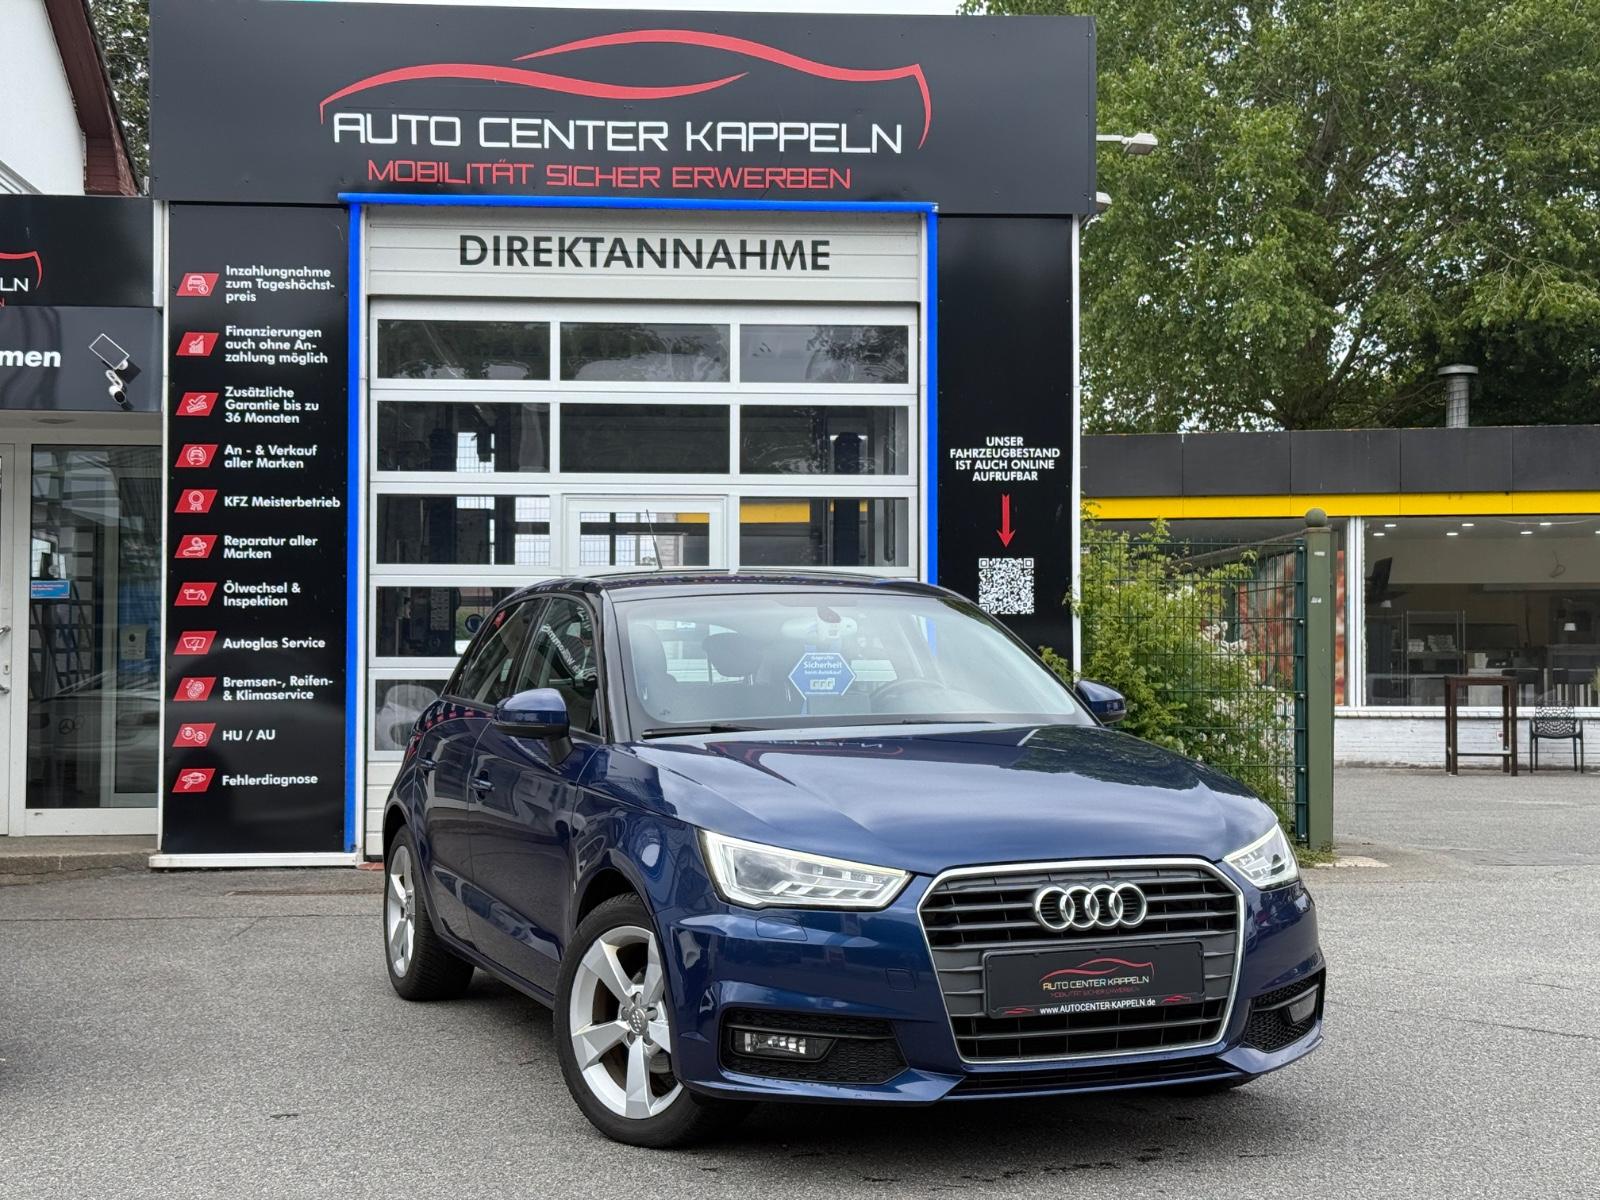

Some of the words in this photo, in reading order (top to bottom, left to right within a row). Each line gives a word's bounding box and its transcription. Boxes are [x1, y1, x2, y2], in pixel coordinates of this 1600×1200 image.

[333, 112, 462, 147] AUTO
[478, 117, 669, 152] CENTER
[685, 120, 902, 154] KAPPELN
[367, 158, 534, 185] MOBILITÄT
[546, 164, 661, 188] SICHER
[672, 166, 851, 190] ERWERBEN
[459, 234, 831, 271] DIREKTANNAHME
[225, 265, 331, 279] Inzahlungnahme
[225, 280, 252, 289] zum
[255, 278, 336, 292] Tageshöchst-
[225, 290, 257, 304] preis
[225, 325, 322, 340] Finanzierungen
[225, 338, 255, 350] auch
[259, 338, 291, 350] ohne
[294, 340, 317, 350] An-
[225, 351, 275, 365] zahlung
[279, 352, 328, 366] möglich
[225, 386, 295, 398] Zusätzliche
[225, 399, 280, 411] Garantie
[283, 399, 301, 411] bis
[304, 402, 319, 411] zu
[225, 412, 241, 423] 36
[244, 412, 300, 424] Monaten
[986, 436, 1024, 447] UNSER
[224, 444, 242, 456] An
[255, 445, 265, 456] &
[268, 444, 318, 456] Verkauf
[949, 448, 1061, 459] FAHRZEUGBESTAND
[224, 457, 253, 469] aller
[256, 457, 304, 469] Marken
[955, 459, 972, 470] IST
[974, 459, 1008, 470] AUCH
[1011, 459, 1055, 470] ONLINE
[972, 471, 1038, 482] AUFRUFBAR
[224, 496, 248, 507] KFZ
[251, 496, 341, 508] Meisterbetrieb
[224, 535, 286, 548] Reparatur
[289, 535, 318, 546] aller
[223, 548, 272, 559] Marken
[223, 580, 288, 594] Ölwechsel
[291, 582, 301, 594] &
[223, 595, 288, 609] Inspektion
[222, 637, 278, 651] Autoglas
[281, 637, 326, 648] Service
[803, 660, 842, 669] Sicherheit
[222, 676, 286, 689] Bremsen-,
[290, 675, 333, 687] Reifen-
[222, 690, 233, 701] &
[236, 689, 314, 701] Klimaservice
[222, 730, 243, 741] HU
[246, 730, 253, 742] /
[255, 730, 276, 740] AU
[222, 774, 318, 787] Fehlerdiagnose
[1043, 981, 1069, 991] AUTO
[1070, 978, 1106, 989] CENTER
[1107, 976, 1150, 986] KAPPELN
[1039, 998, 1156, 1015] www.AUTOCENTER-KAPPELN.de
